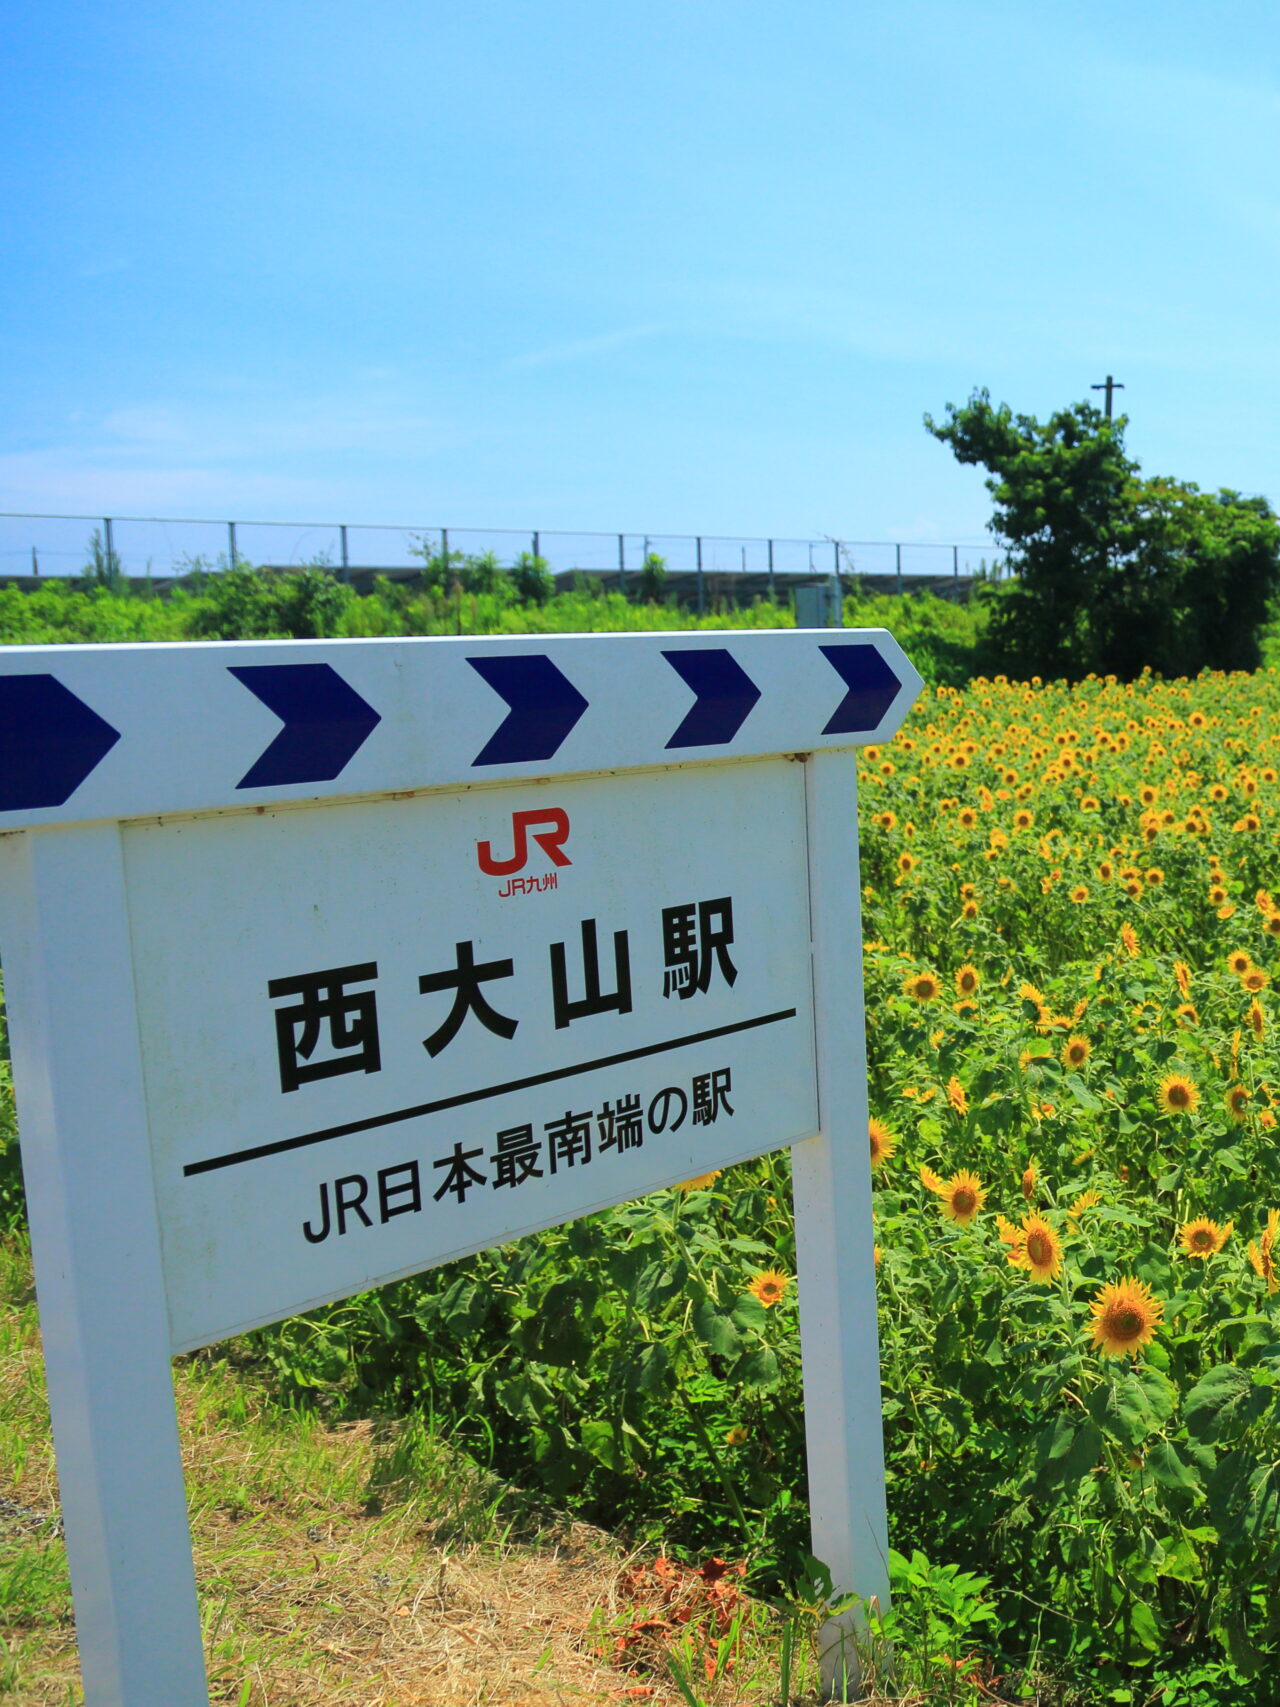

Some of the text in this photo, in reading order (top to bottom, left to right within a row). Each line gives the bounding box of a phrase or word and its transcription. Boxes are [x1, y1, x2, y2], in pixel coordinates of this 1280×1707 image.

[477, 807, 573, 876] JR
[498, 872, 558, 898] JR九州
[267, 897, 738, 1093] 西大山駅
[303, 1067, 735, 1244] JR日本最南端の駅
